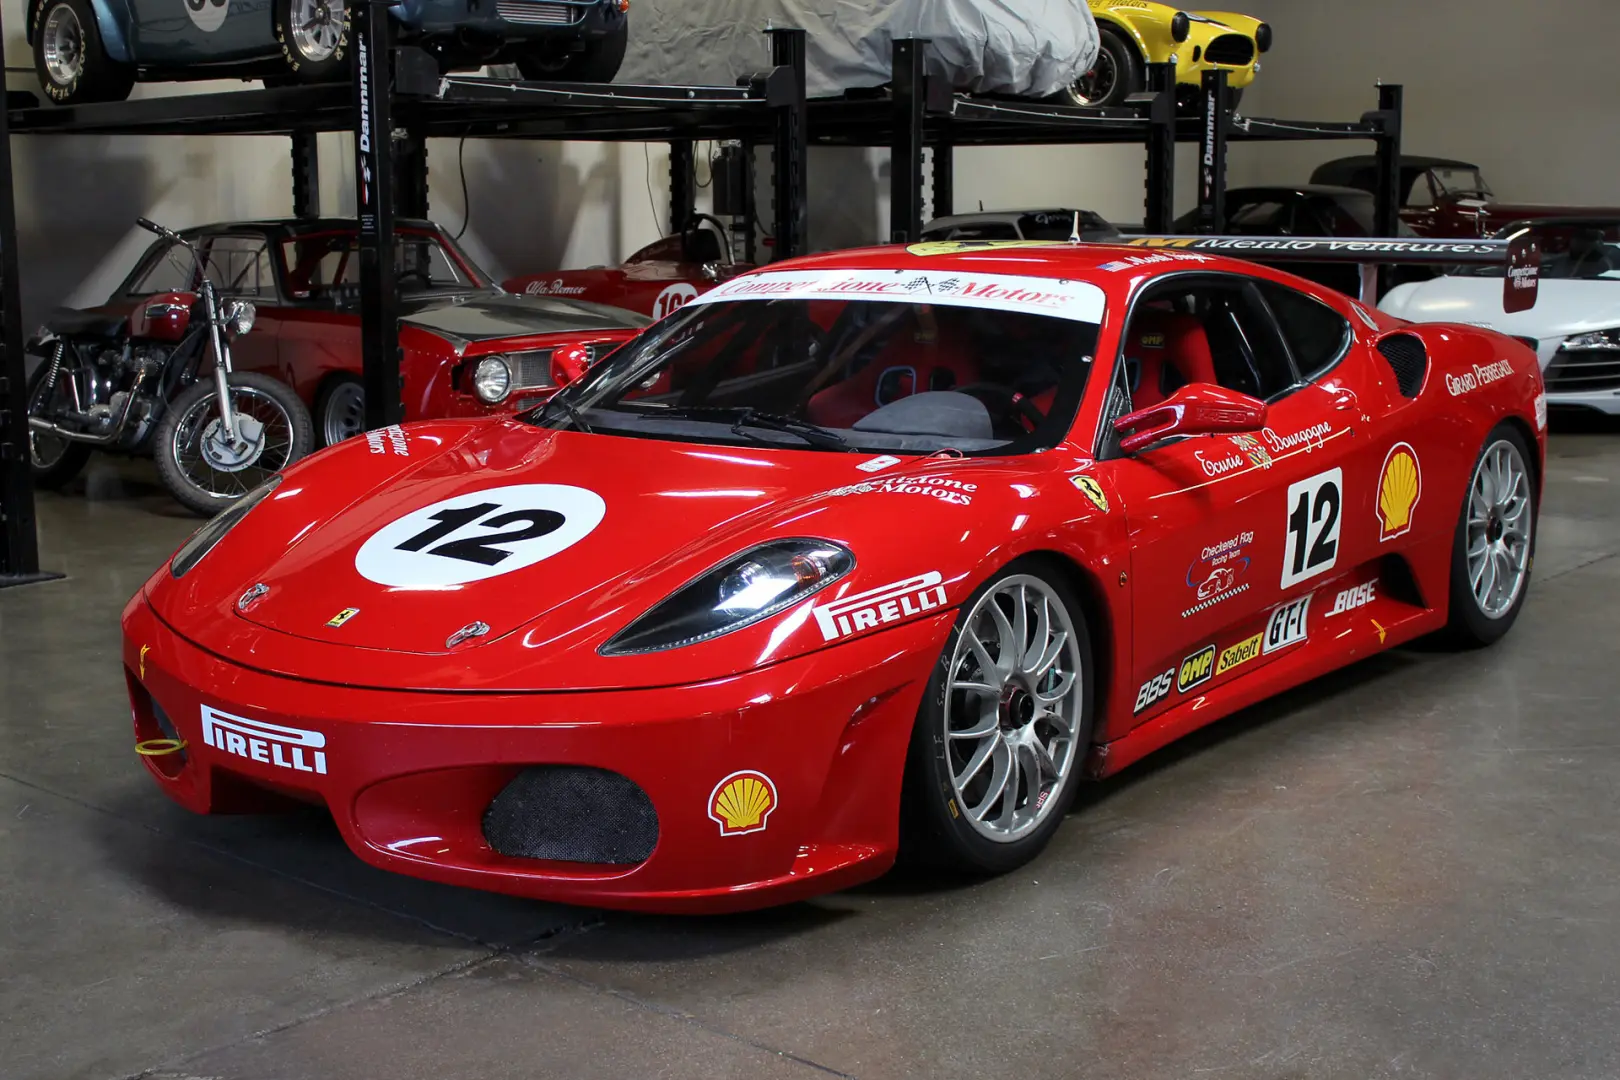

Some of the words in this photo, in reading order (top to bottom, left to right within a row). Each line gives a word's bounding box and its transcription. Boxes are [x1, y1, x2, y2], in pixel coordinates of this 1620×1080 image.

[1194, 239, 1317, 250] Menlo
[525, 280, 548, 295] Alfa
[549, 278, 587, 295] Romeo
[951, 282, 1075, 304] Motors
[1194, 450, 1243, 477] Ecurie
[1262, 421, 1331, 453] Bourgogne
[876, 483, 972, 506] Motors
[393, 502, 566, 567] 12
[1201, 535, 1239, 560] Checkered
[1238, 531, 1254, 551] Flag
[1289, 481, 1340, 576] 12
[1212, 553, 1227, 567] Racing
[1228, 549, 1241, 561] Team
[812, 570, 947, 642] PIRELLI
[1326, 578, 1378, 617] BOSE
[1269, 595, 1309, 646] GT-1
[1220, 636, 1259, 670] Sabelt
[1133, 667, 1176, 714] BBS
[200, 703, 327, 775] PIRELLI
